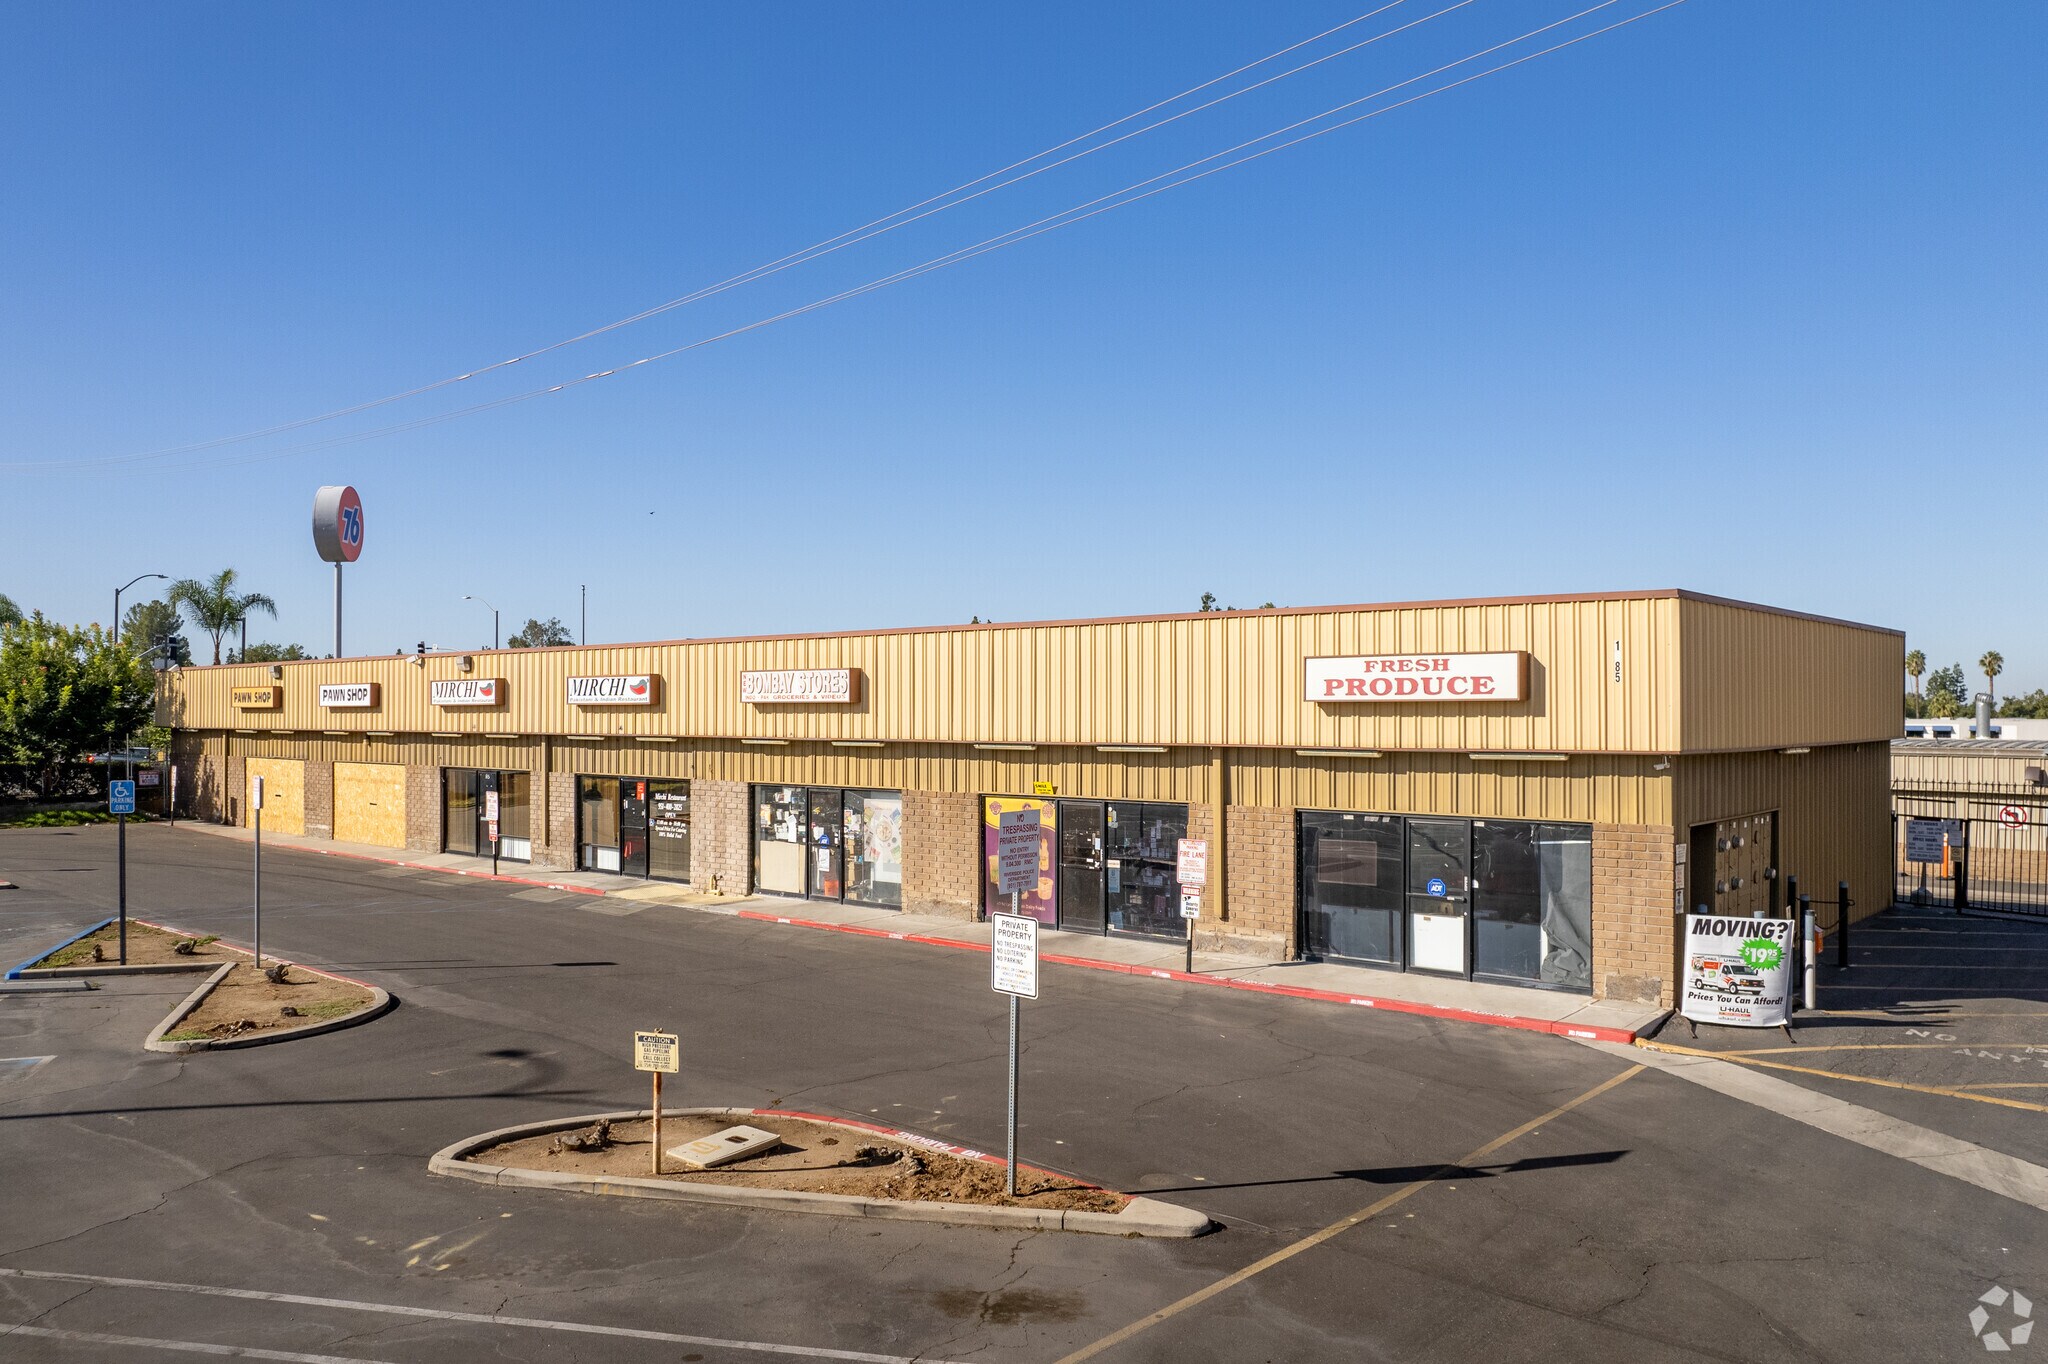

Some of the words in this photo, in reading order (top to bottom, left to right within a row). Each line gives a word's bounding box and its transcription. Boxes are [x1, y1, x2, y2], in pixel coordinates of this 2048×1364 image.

[342, 505, 361, 547] 76
[1364, 658, 1450, 673] FRESH
[570, 678, 627, 697] MIRCHI
[747, 672, 795, 694] BOMBAY
[799, 671, 848, 694] STORES
[1323, 676, 1496, 696] PRODUCE
[323, 688, 345, 702] PAWN
[347, 687, 368, 701] SHOP
[433, 681, 478, 698] MIRCHI
[233, 692, 252, 703] PAWN
[254, 691, 272, 703] SHOP
[1016, 814, 1024, 822] NO
[1002, 823, 1038, 835] TRESPASSING
[1000, 836, 1017, 845] PRIVATE
[1017, 834, 1039, 843] PROPERTY
[1001, 853, 1018, 861] WITHOUT
[1018, 852, 1038, 860] PERMISSION
[1179, 850, 1190, 858] FIRE
[1191, 851, 1205, 859] LANE
[1007, 874, 1031, 882] DEPARTMENT
[1431, 884, 1443, 892] ADT
[1002, 920, 1028, 931] PRIVATE
[1692, 918, 1789, 940] MOVING?
[998, 929, 1032, 941] PROPERTY
[1004, 941, 1034, 952] TRESPASSING
[1004, 948, 1026, 958] LOITERING
[1004, 956, 1023, 966] PARKING
[1688, 991, 1713, 1001] Prices
[1717, 994, 1732, 1003] You
[1734, 996, 1751, 1004] Can
[1753, 996, 1783, 1005] Afford!
[643, 1036, 671, 1044] CAUTION
[1905, 1028, 1957, 1041] NO
[895, 1131, 957, 1151] PARKING
[960, 1149, 986, 1159] NO
